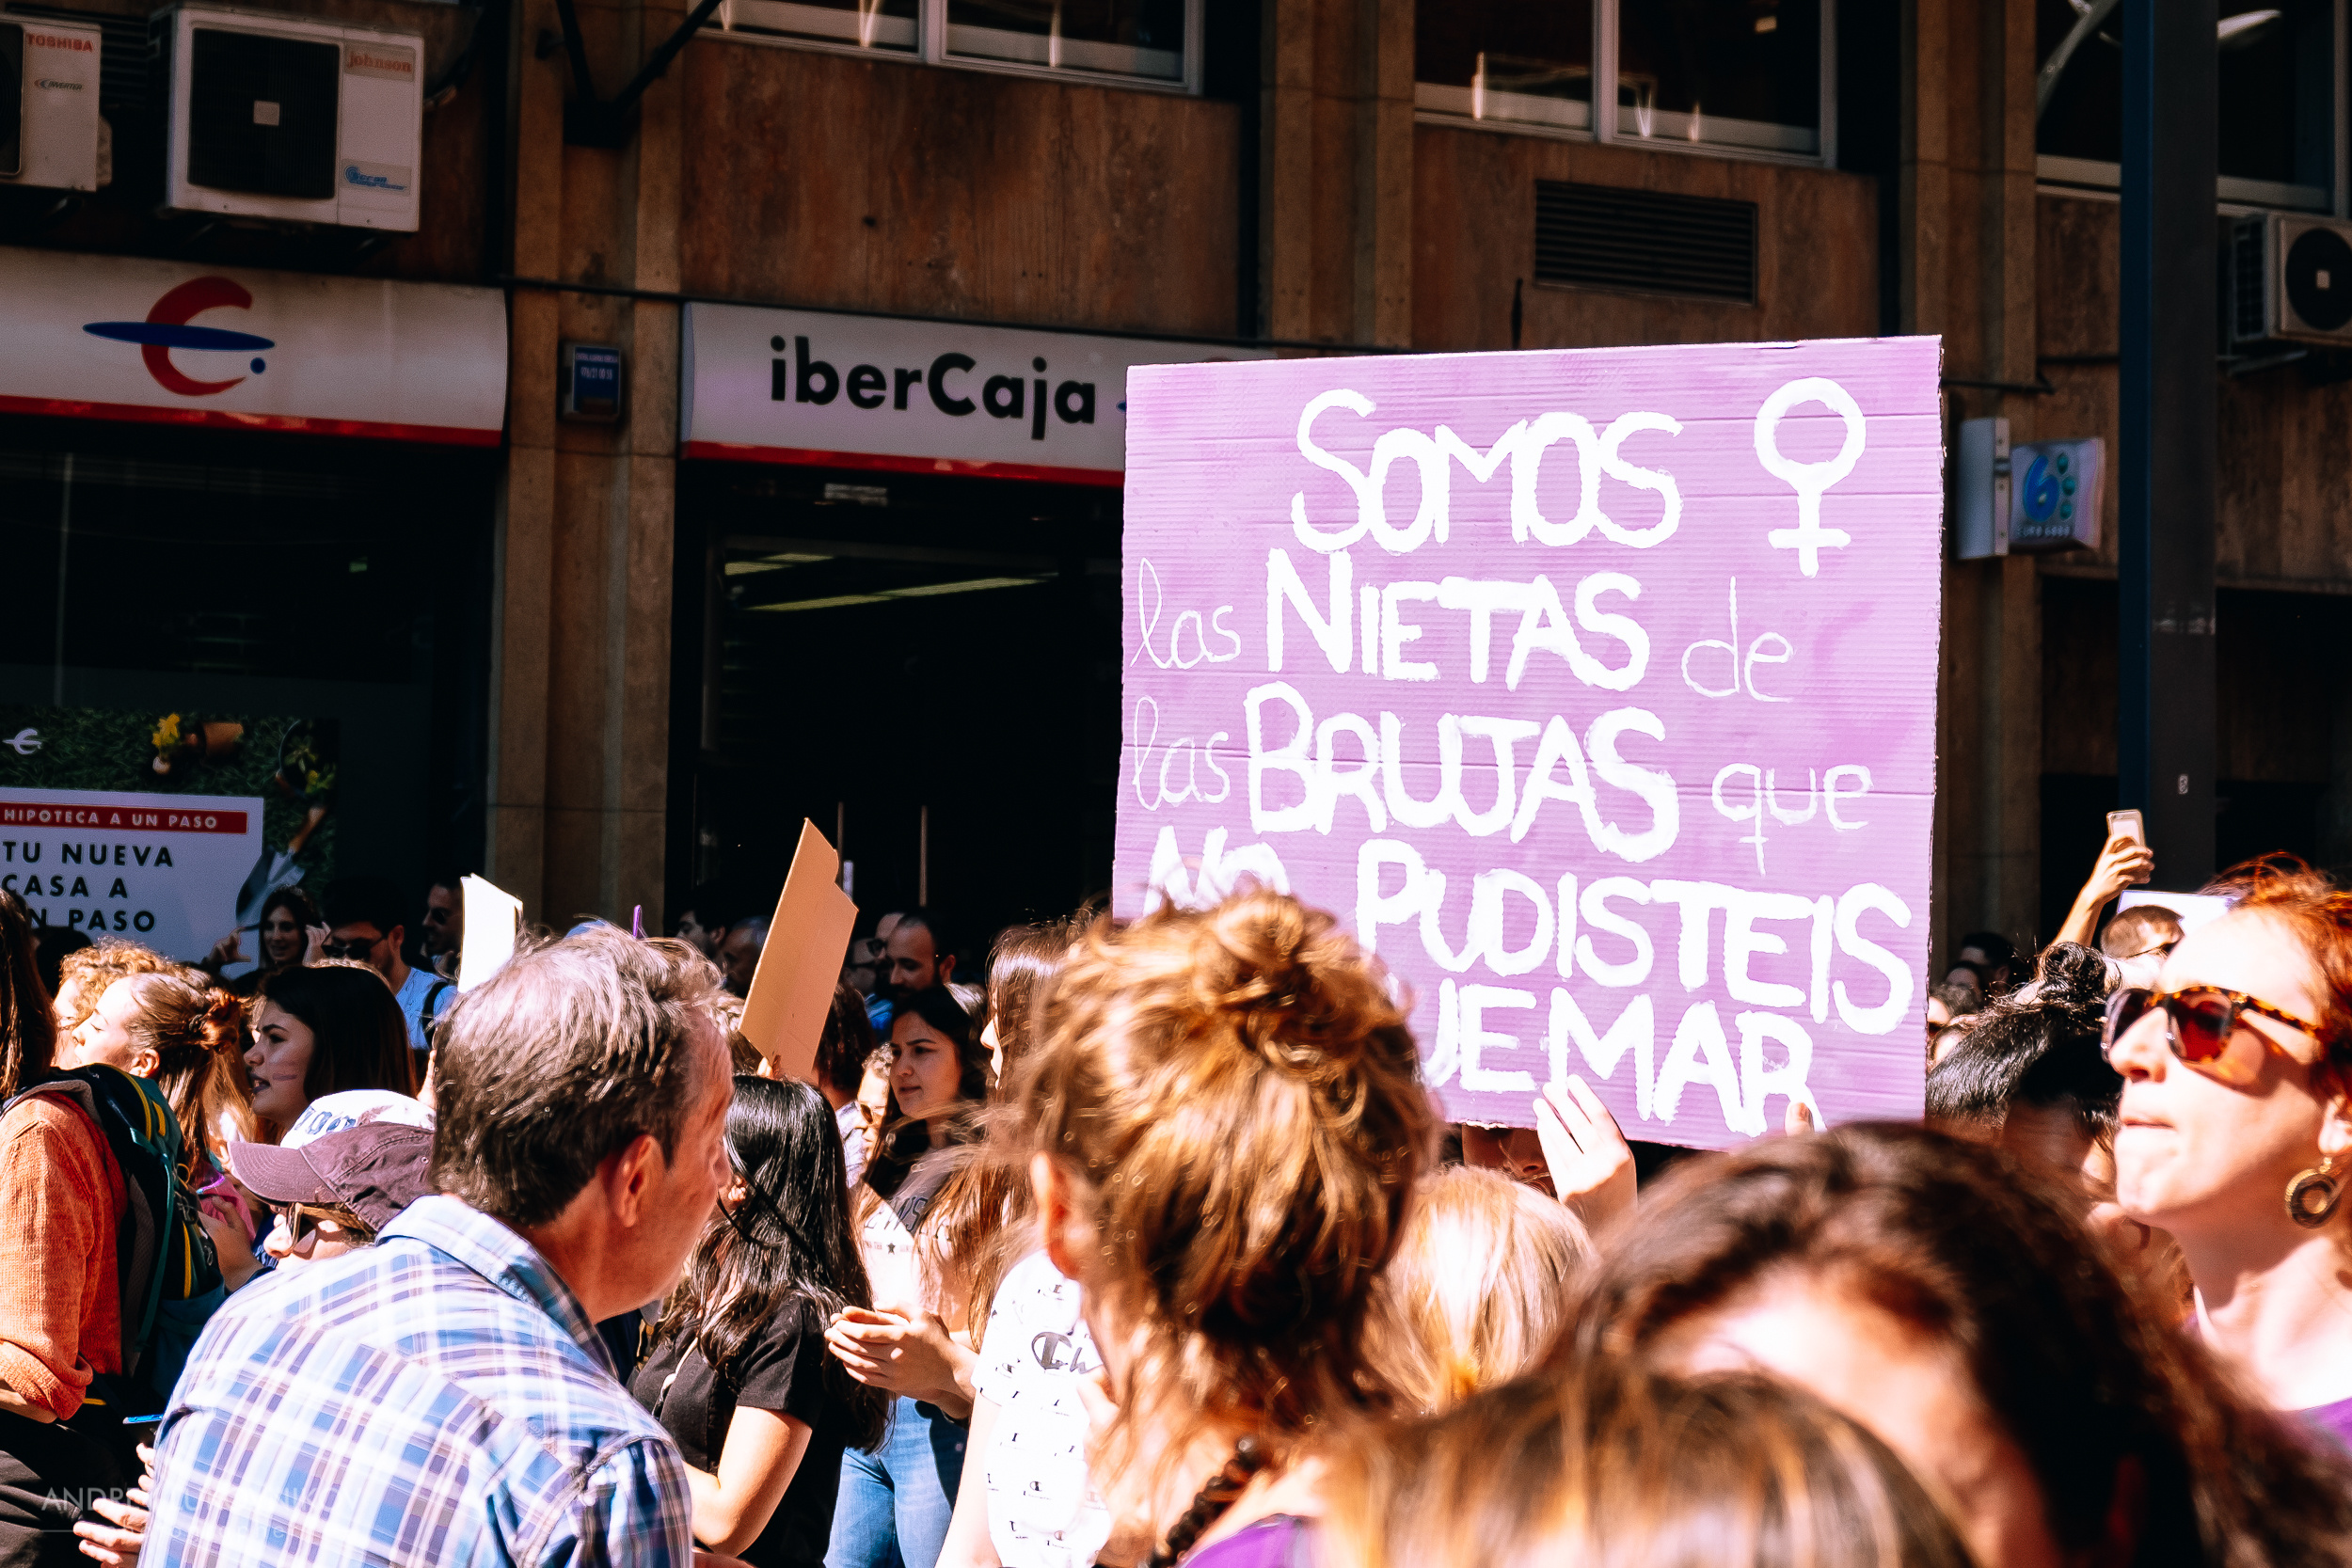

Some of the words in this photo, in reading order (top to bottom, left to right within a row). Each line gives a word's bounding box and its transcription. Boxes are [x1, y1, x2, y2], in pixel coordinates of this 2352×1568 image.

[25, 33, 93, 53] TOSHIBA
[47, 80, 83, 91] INVERTER
[770, 334, 1097, 441] iberCaja
[1291, 388, 1684, 555] SOMOS
[1129, 557, 1242, 670] las
[1266, 547, 1652, 692] NIETAS
[1681, 576, 1795, 703] de
[1132, 695, 1231, 811] las
[1244, 681, 1680, 863] BRUJAS
[1711, 763, 1874, 878] que
[4, 809, 100, 825] HIPOTECA
[109, 813, 121, 825] A
[132, 814, 158, 827] UN
[168, 816, 217, 830] PASO
[1, 873, 89, 898] CASA
[108, 878, 128, 899] A
[2, 841, 40, 863] TU
[61, 843, 173, 868] NUEVA
[28, 908, 48, 929] N
[69, 908, 155, 933] PASO
[1355, 838, 1915, 1036] PUDISTEIS
[1402, 974, 1827, 1138] UEMAR
